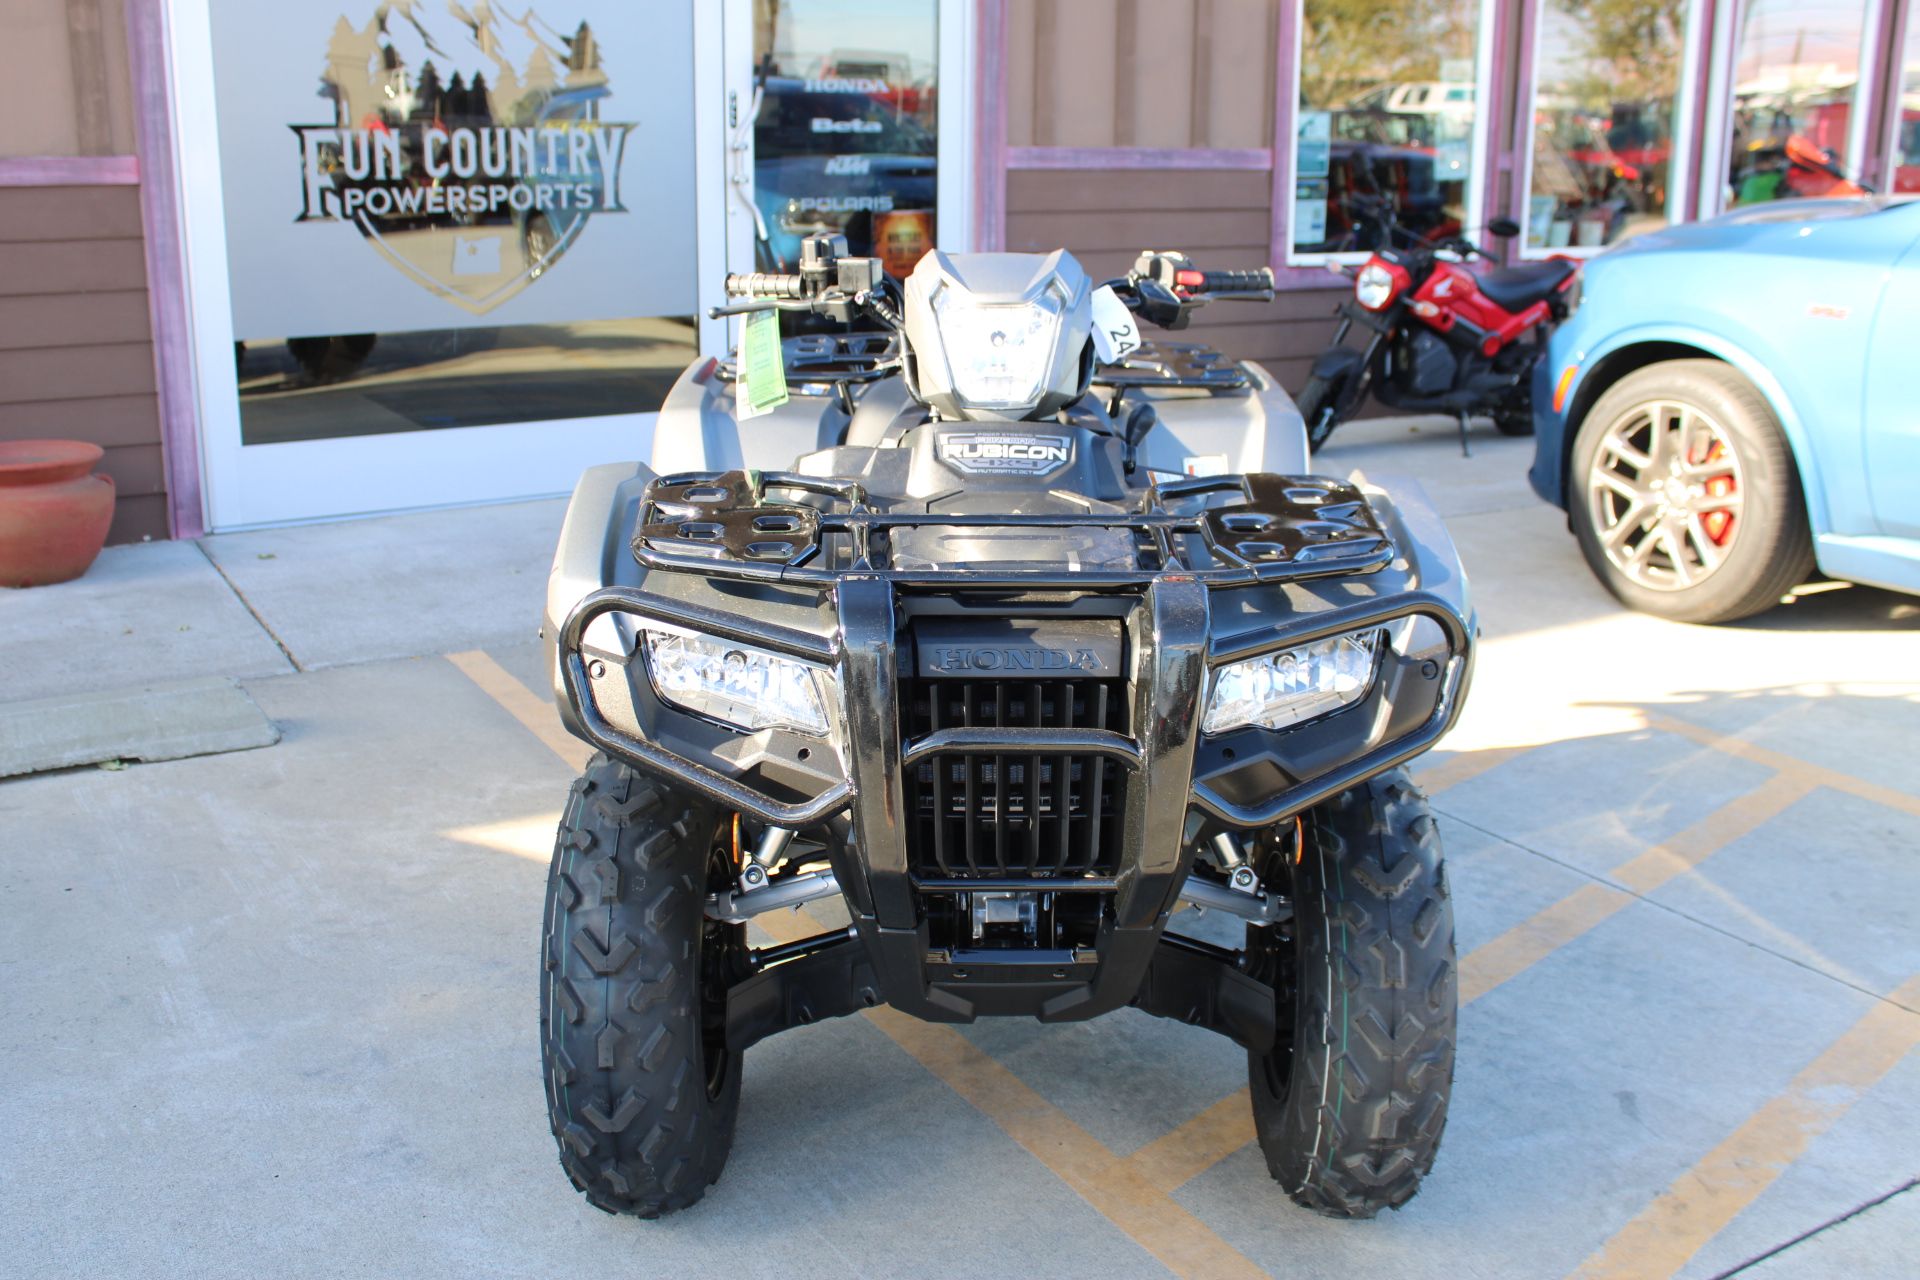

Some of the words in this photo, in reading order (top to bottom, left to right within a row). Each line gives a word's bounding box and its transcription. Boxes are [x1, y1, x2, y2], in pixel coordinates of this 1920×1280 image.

[803, 78, 890, 93] HONDA
[810, 117, 883, 133] Beta
[300, 127, 402, 218] FUN
[423, 126, 627, 210] COUNTRY
[825, 154, 871, 175] KTM
[345, 183, 594, 216] POWERSPORTS
[801, 196, 894, 212] POLARIS
[942, 444, 1067, 461] RUBICON
[935, 648, 1108, 670] HONDA
